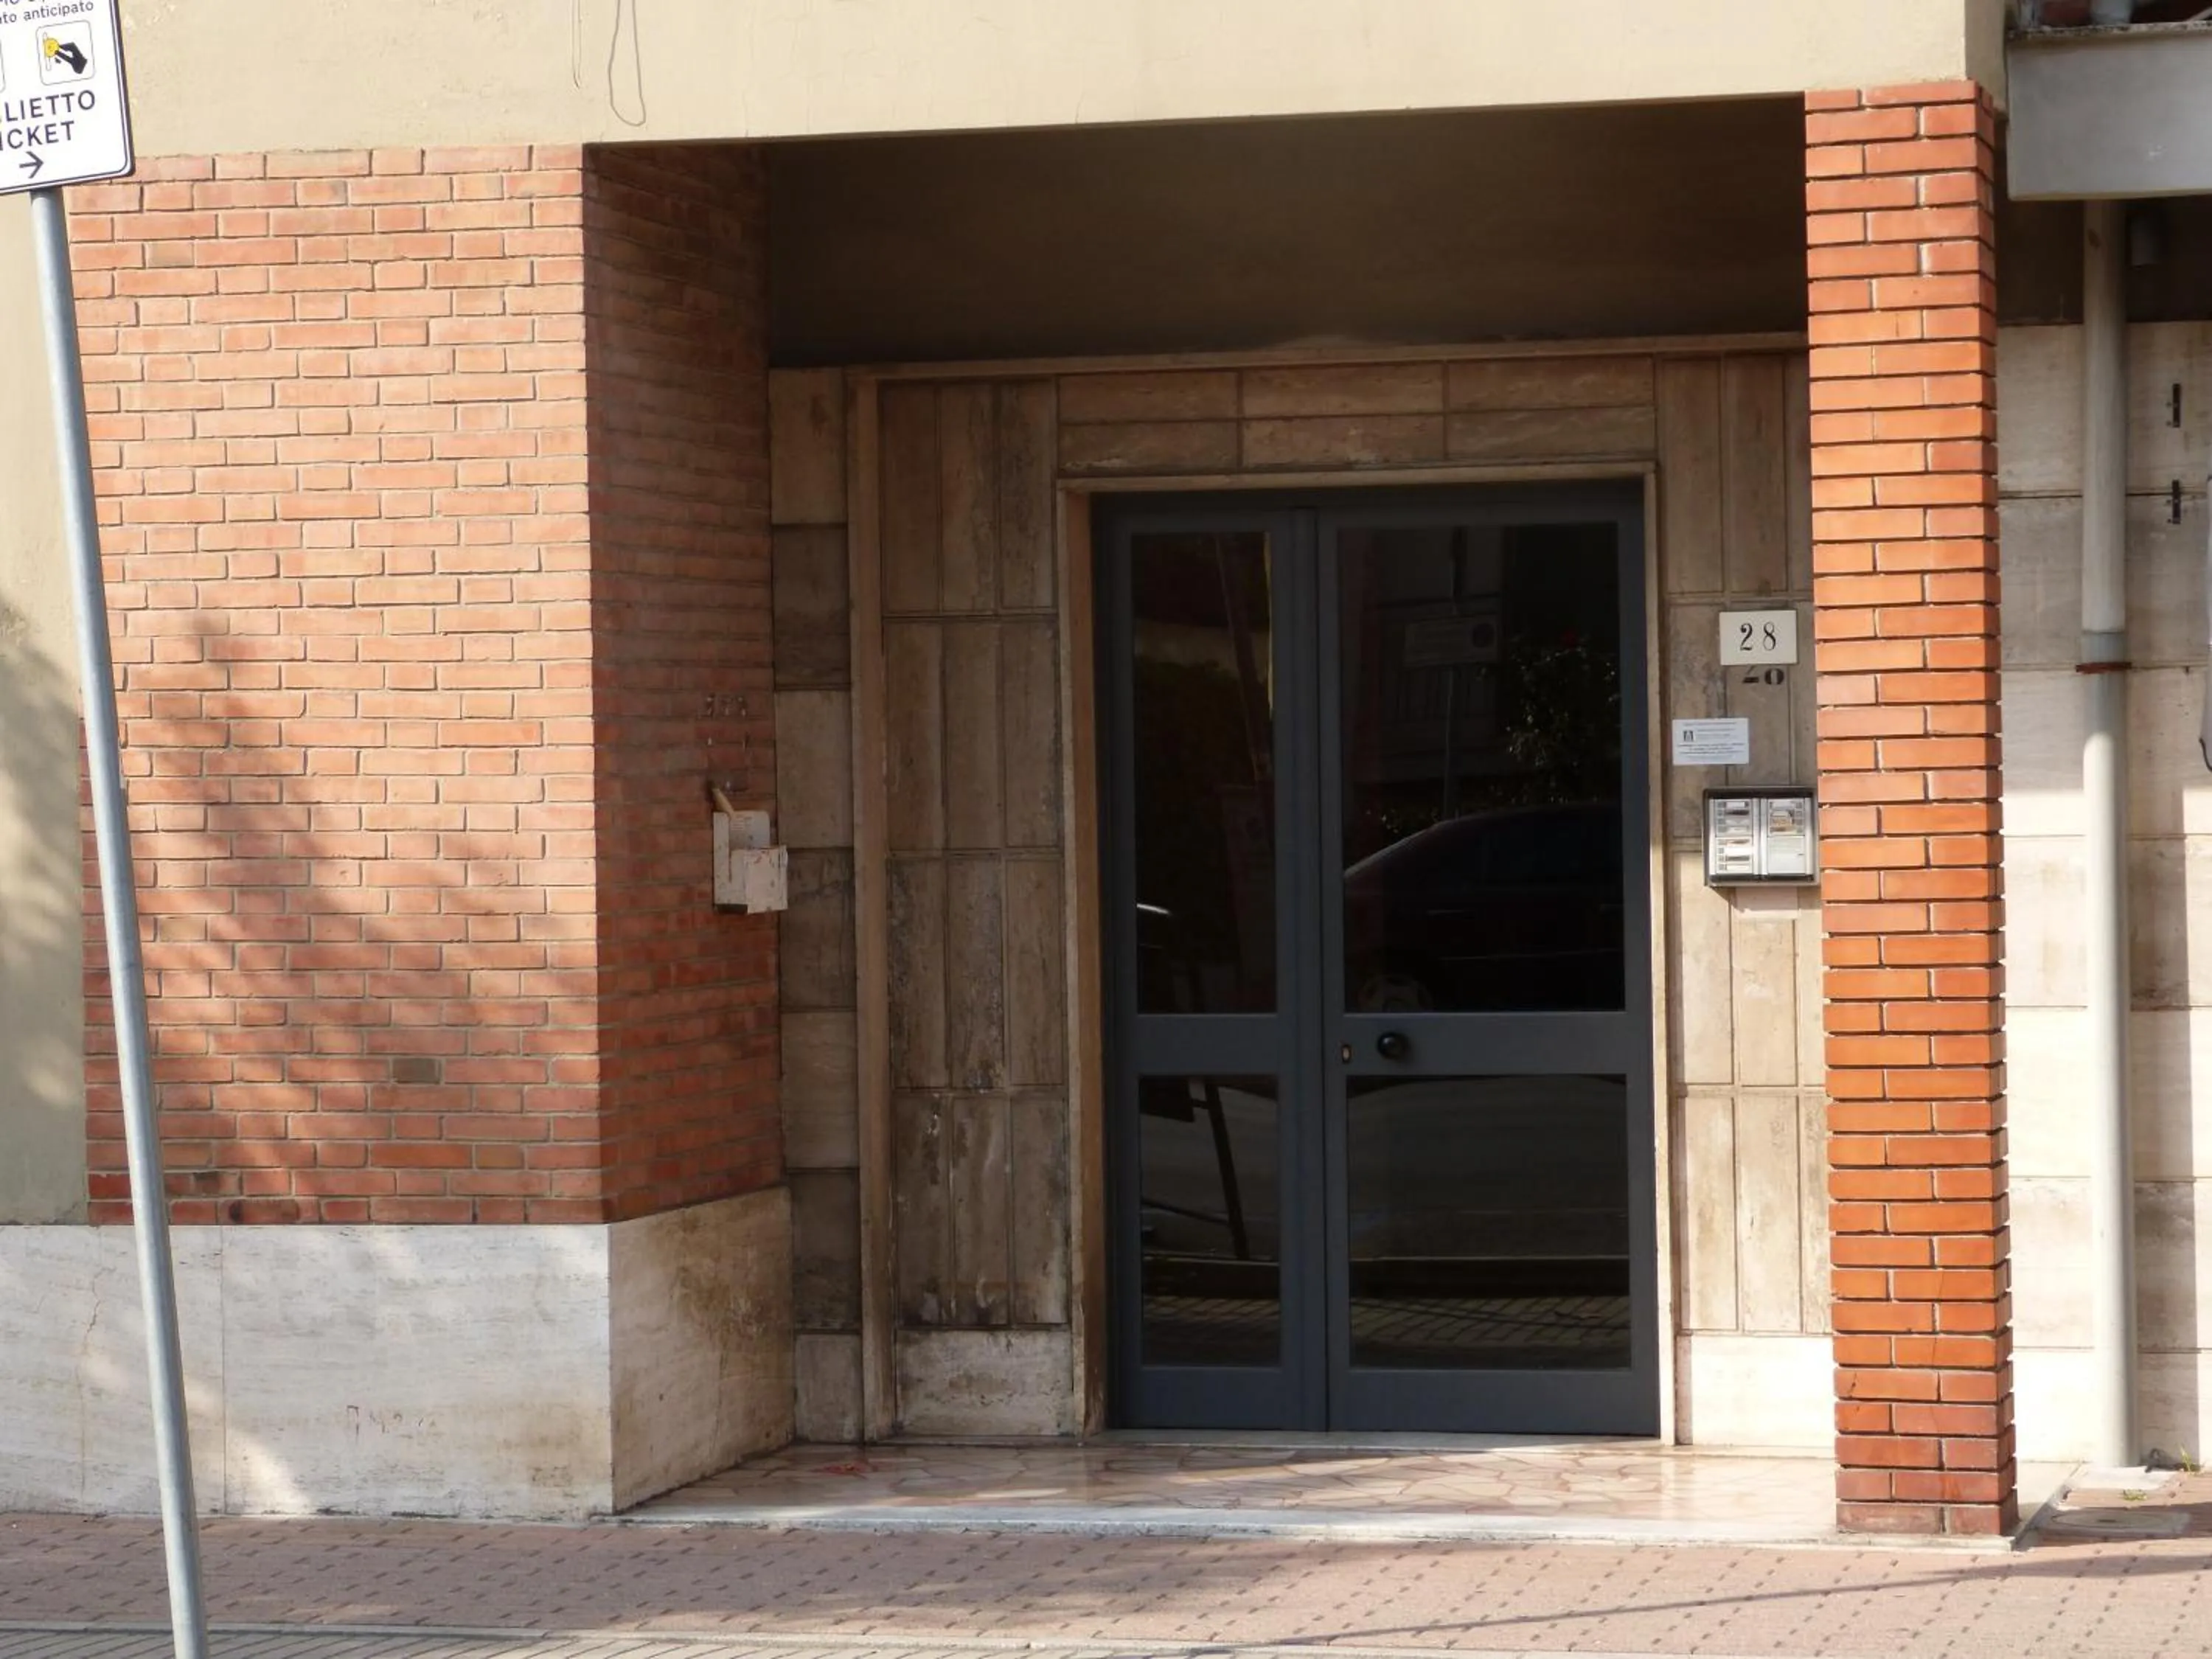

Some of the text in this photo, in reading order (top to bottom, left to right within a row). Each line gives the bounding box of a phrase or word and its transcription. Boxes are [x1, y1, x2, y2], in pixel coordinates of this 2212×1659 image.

[0, 1, 94, 24] to anticipato
[0, 89, 95, 122] LIETTO
[1740, 622, 1776, 651] 28
